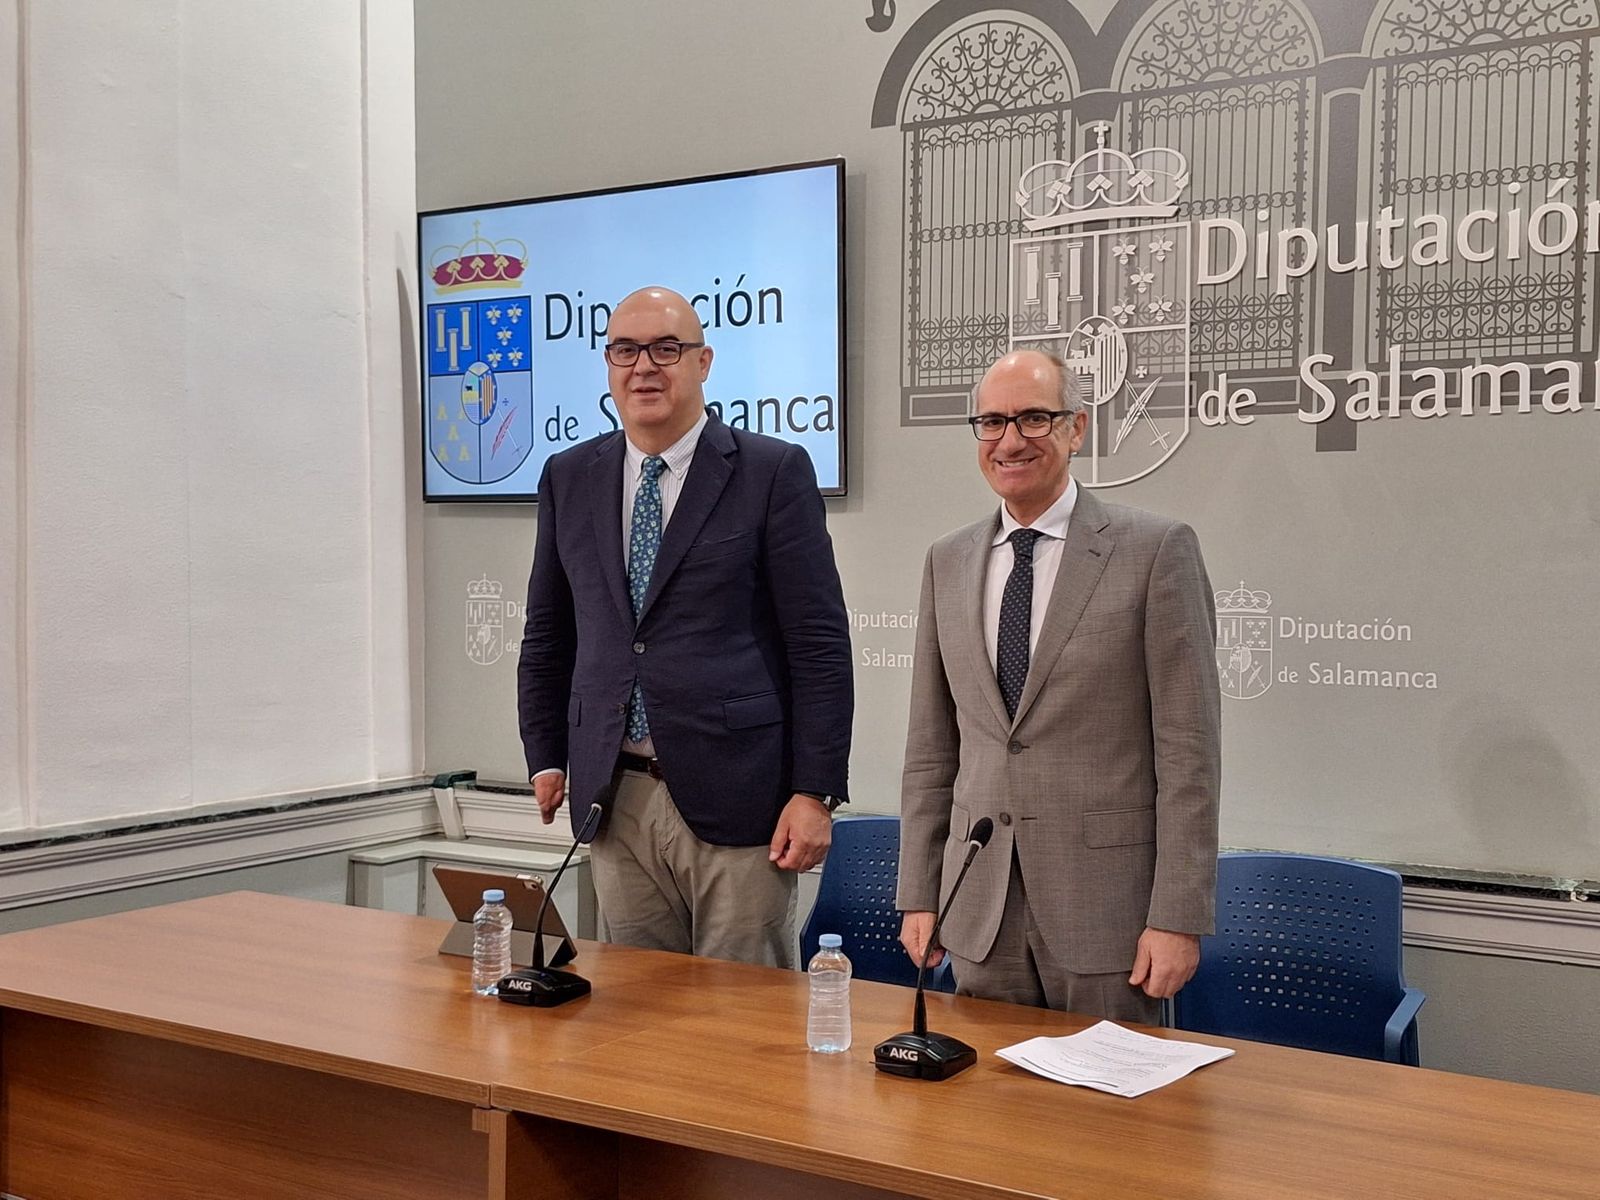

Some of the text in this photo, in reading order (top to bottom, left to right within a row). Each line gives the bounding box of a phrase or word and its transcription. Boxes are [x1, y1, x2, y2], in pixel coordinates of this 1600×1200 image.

[545, 274, 783, 350] Dipción
[1198, 344, 1600, 426] de Salama
[545, 393, 835, 442] de Sanca
[1279, 616, 1412, 644] Diputación
[861, 647, 913, 668] Salam
[1278, 662, 1438, 689] de Salamanca
[508, 979, 532, 991] AKG
[889, 1047, 919, 1061] AKG
